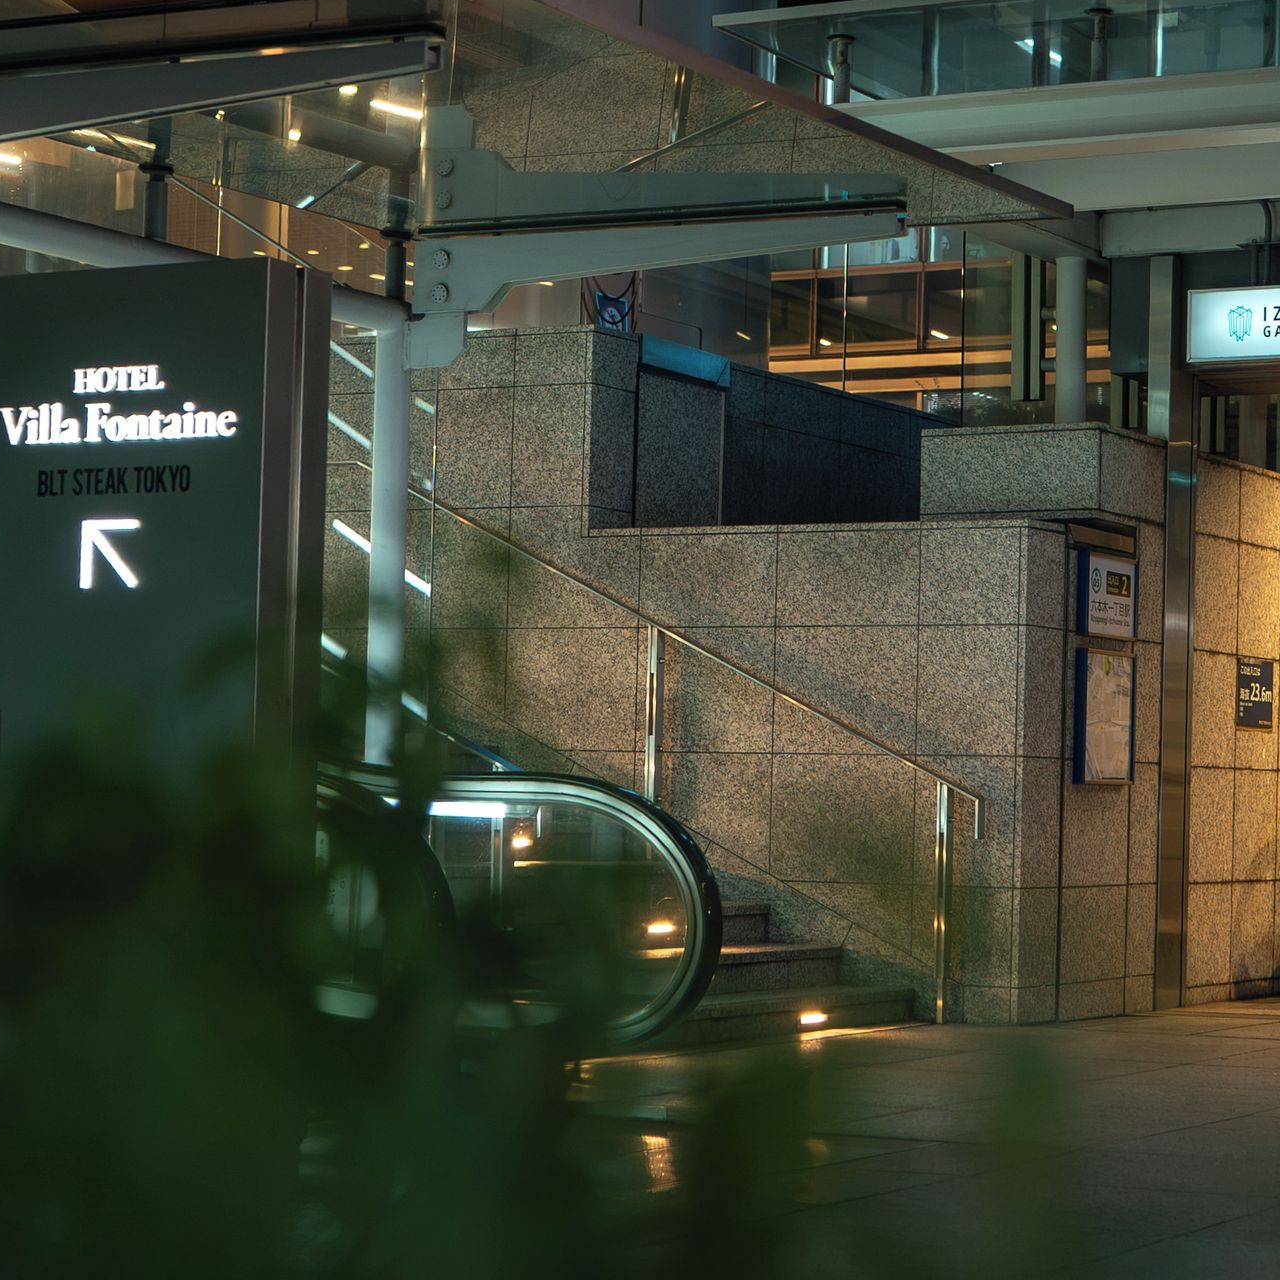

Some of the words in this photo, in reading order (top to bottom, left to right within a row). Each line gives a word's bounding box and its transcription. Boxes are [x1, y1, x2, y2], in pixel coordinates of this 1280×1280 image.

[72, 364, 166, 394] HOTEL
[0, 402, 82, 446] Villa
[83, 401, 239, 443] Fontaine
[37, 469, 68, 497] BLT
[72, 467, 129, 496] STEAK
[134, 465, 191, 494] TOKYO
[1121, 576, 1128, 595] 2
